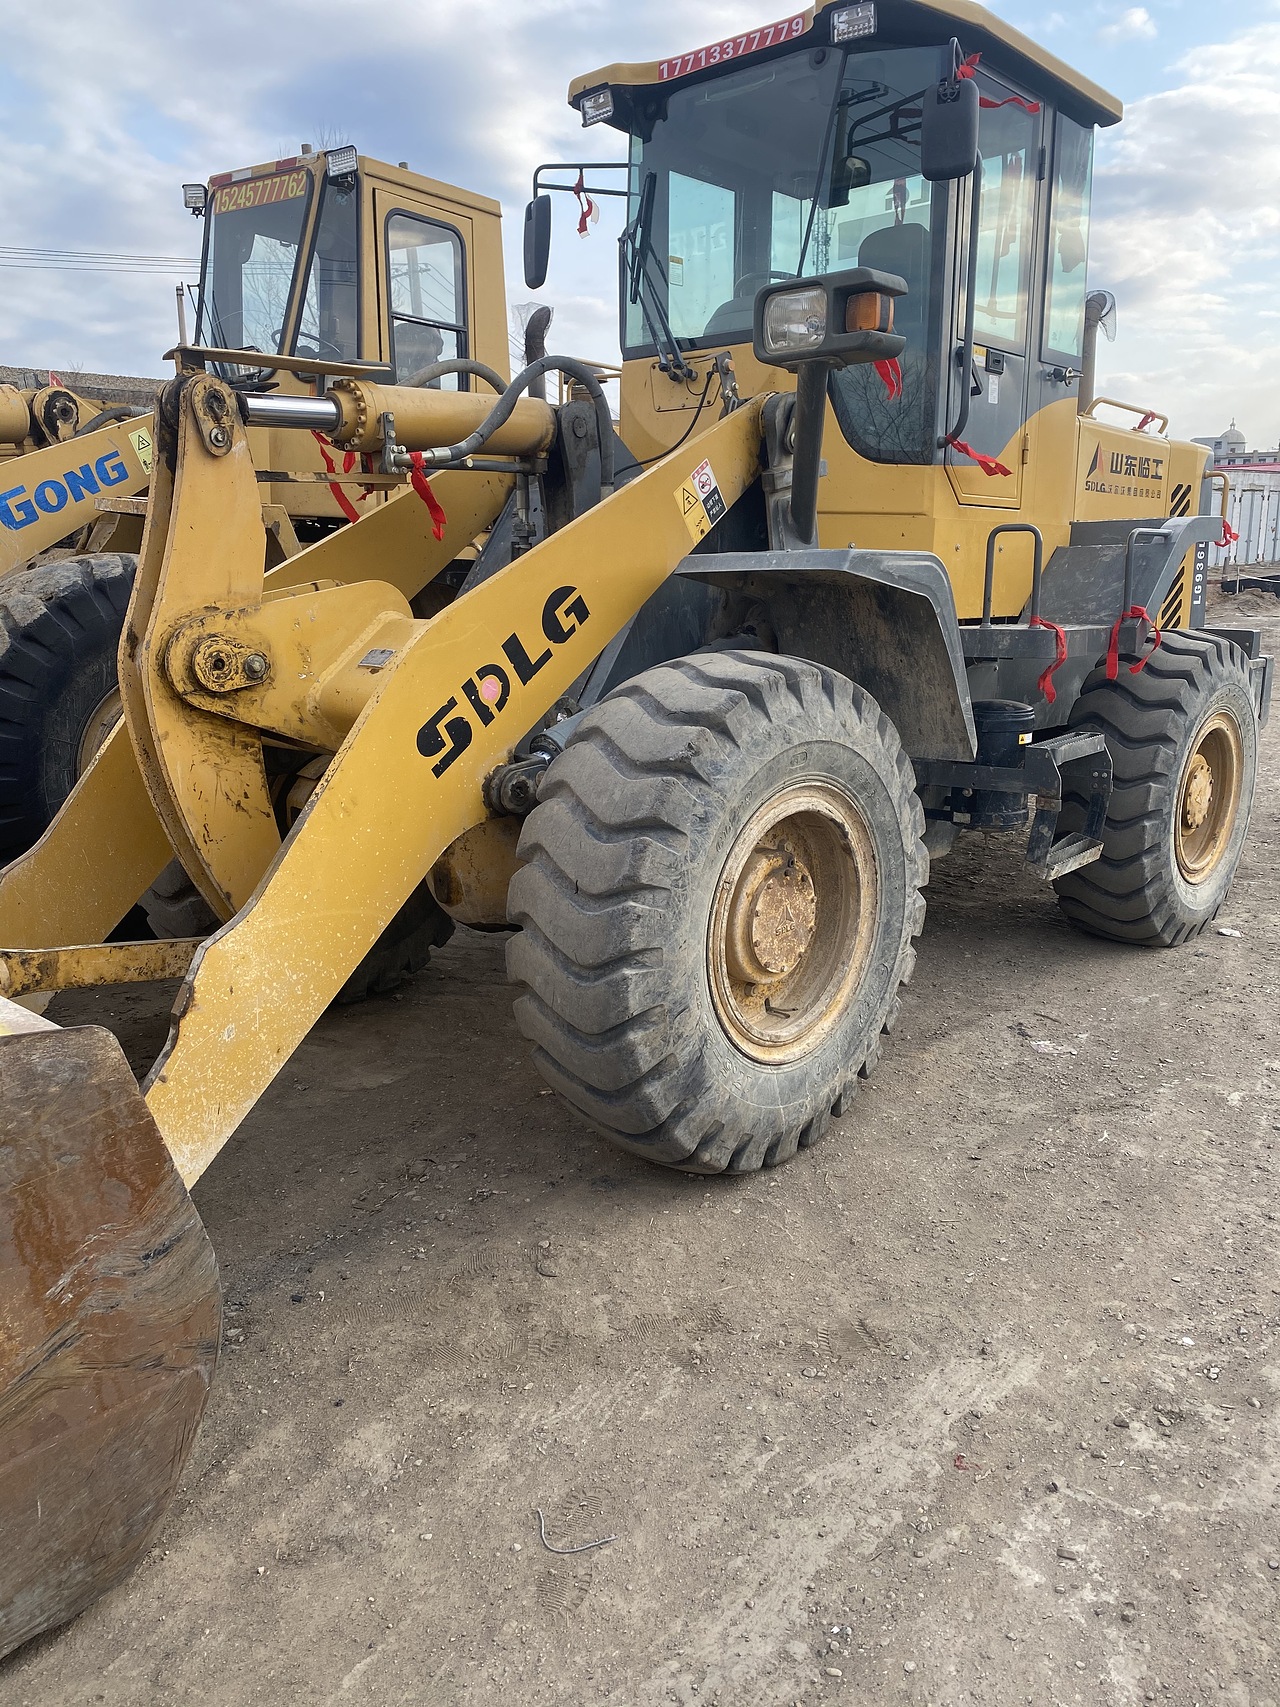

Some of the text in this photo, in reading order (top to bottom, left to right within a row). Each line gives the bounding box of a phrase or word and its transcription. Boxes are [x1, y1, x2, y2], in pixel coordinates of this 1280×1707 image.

[659, 17, 803, 79] 17713377779
[215, 170, 306, 213] 15245777762
[0, 450, 130, 531] GONG
[1085, 480, 1106, 493] SDLG
[1110, 451, 1164, 480] 山东临工
[416, 585, 591, 779] SDLG
